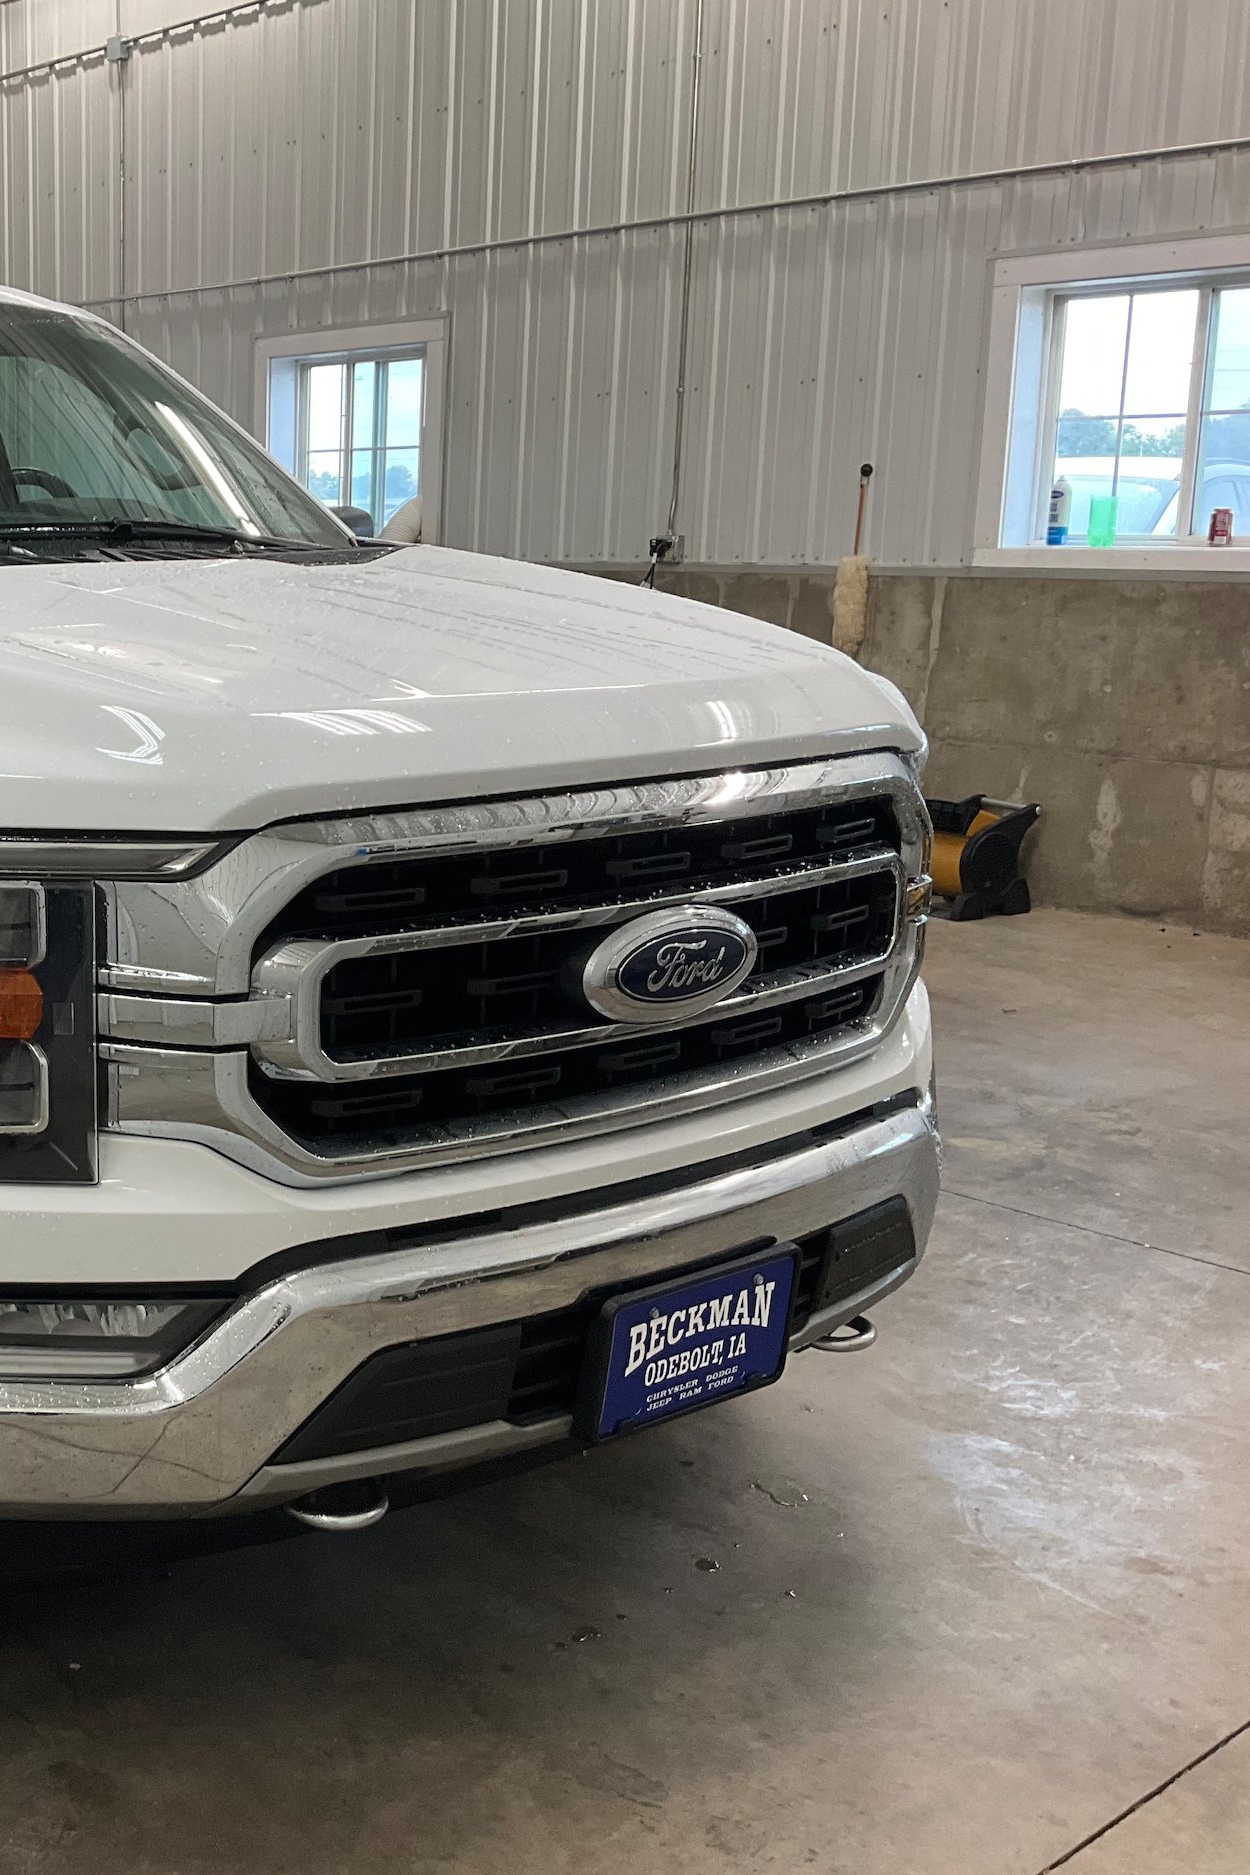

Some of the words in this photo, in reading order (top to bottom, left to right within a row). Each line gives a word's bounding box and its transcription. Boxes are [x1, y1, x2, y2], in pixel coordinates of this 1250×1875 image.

[647, 939, 726, 992] Ford
[624, 1281, 776, 1379] BECKMAN
[644, 1340, 725, 1387] ODEBOLT,
[727, 1332, 747, 1359] IA
[646, 1378, 699, 1403] CHRYSLER
[705, 1365, 739, 1383] DODGE
[646, 1397, 673, 1412] JEEP
[679, 1386, 703, 1400] RAM
[707, 1376, 734, 1391] FORD
